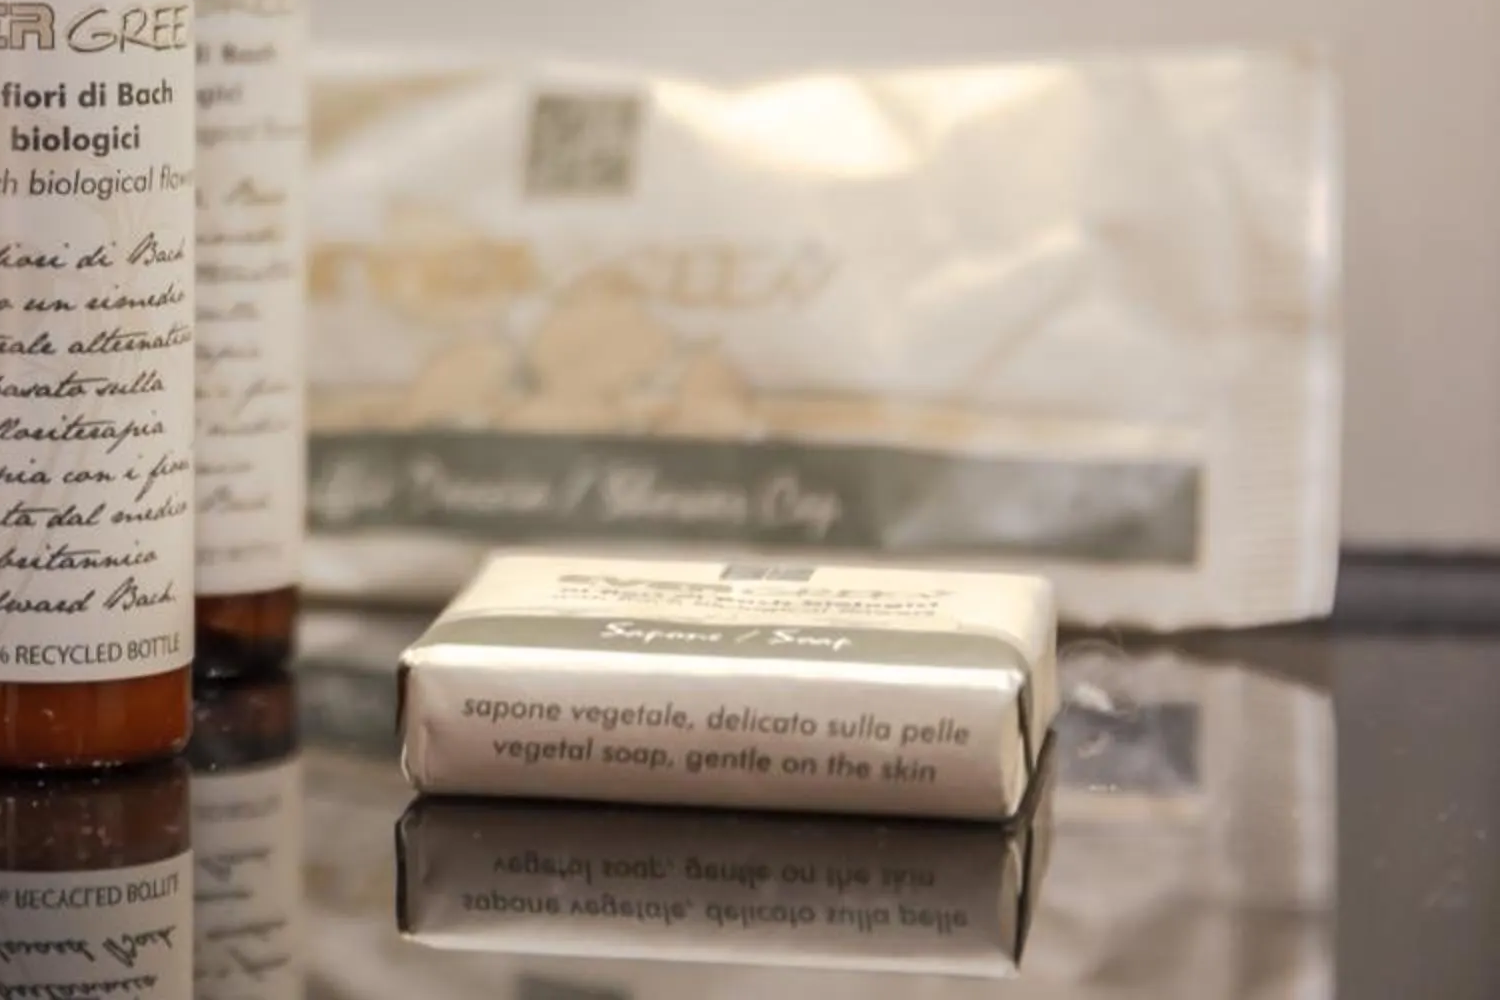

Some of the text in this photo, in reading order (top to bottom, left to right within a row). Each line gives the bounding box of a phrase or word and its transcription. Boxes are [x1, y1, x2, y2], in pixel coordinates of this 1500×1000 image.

[67, 5, 189, 53] GREE
[2, 81, 67, 109] fiori
[77, 81, 107, 108] di
[117, 78, 174, 107] Bach
[10, 125, 141, 157] biologici
[28, 165, 153, 201] biological
[76, 242, 117, 270] di
[23, 293, 77, 313] un
[95, 368, 166, 399] sulla
[62, 468, 116, 485] con
[45, 502, 107, 528] dal
[15, 638, 122, 667] RECYCLED
[127, 632, 181, 661] BOTTLE
[601, 620, 724, 644] Sapone
[768, 629, 853, 652] Soap
[461, 697, 971, 750] sapone vegetale, delicato sulla pelle
[492, 737, 937, 783] vegetal soap, gentle on the skin
